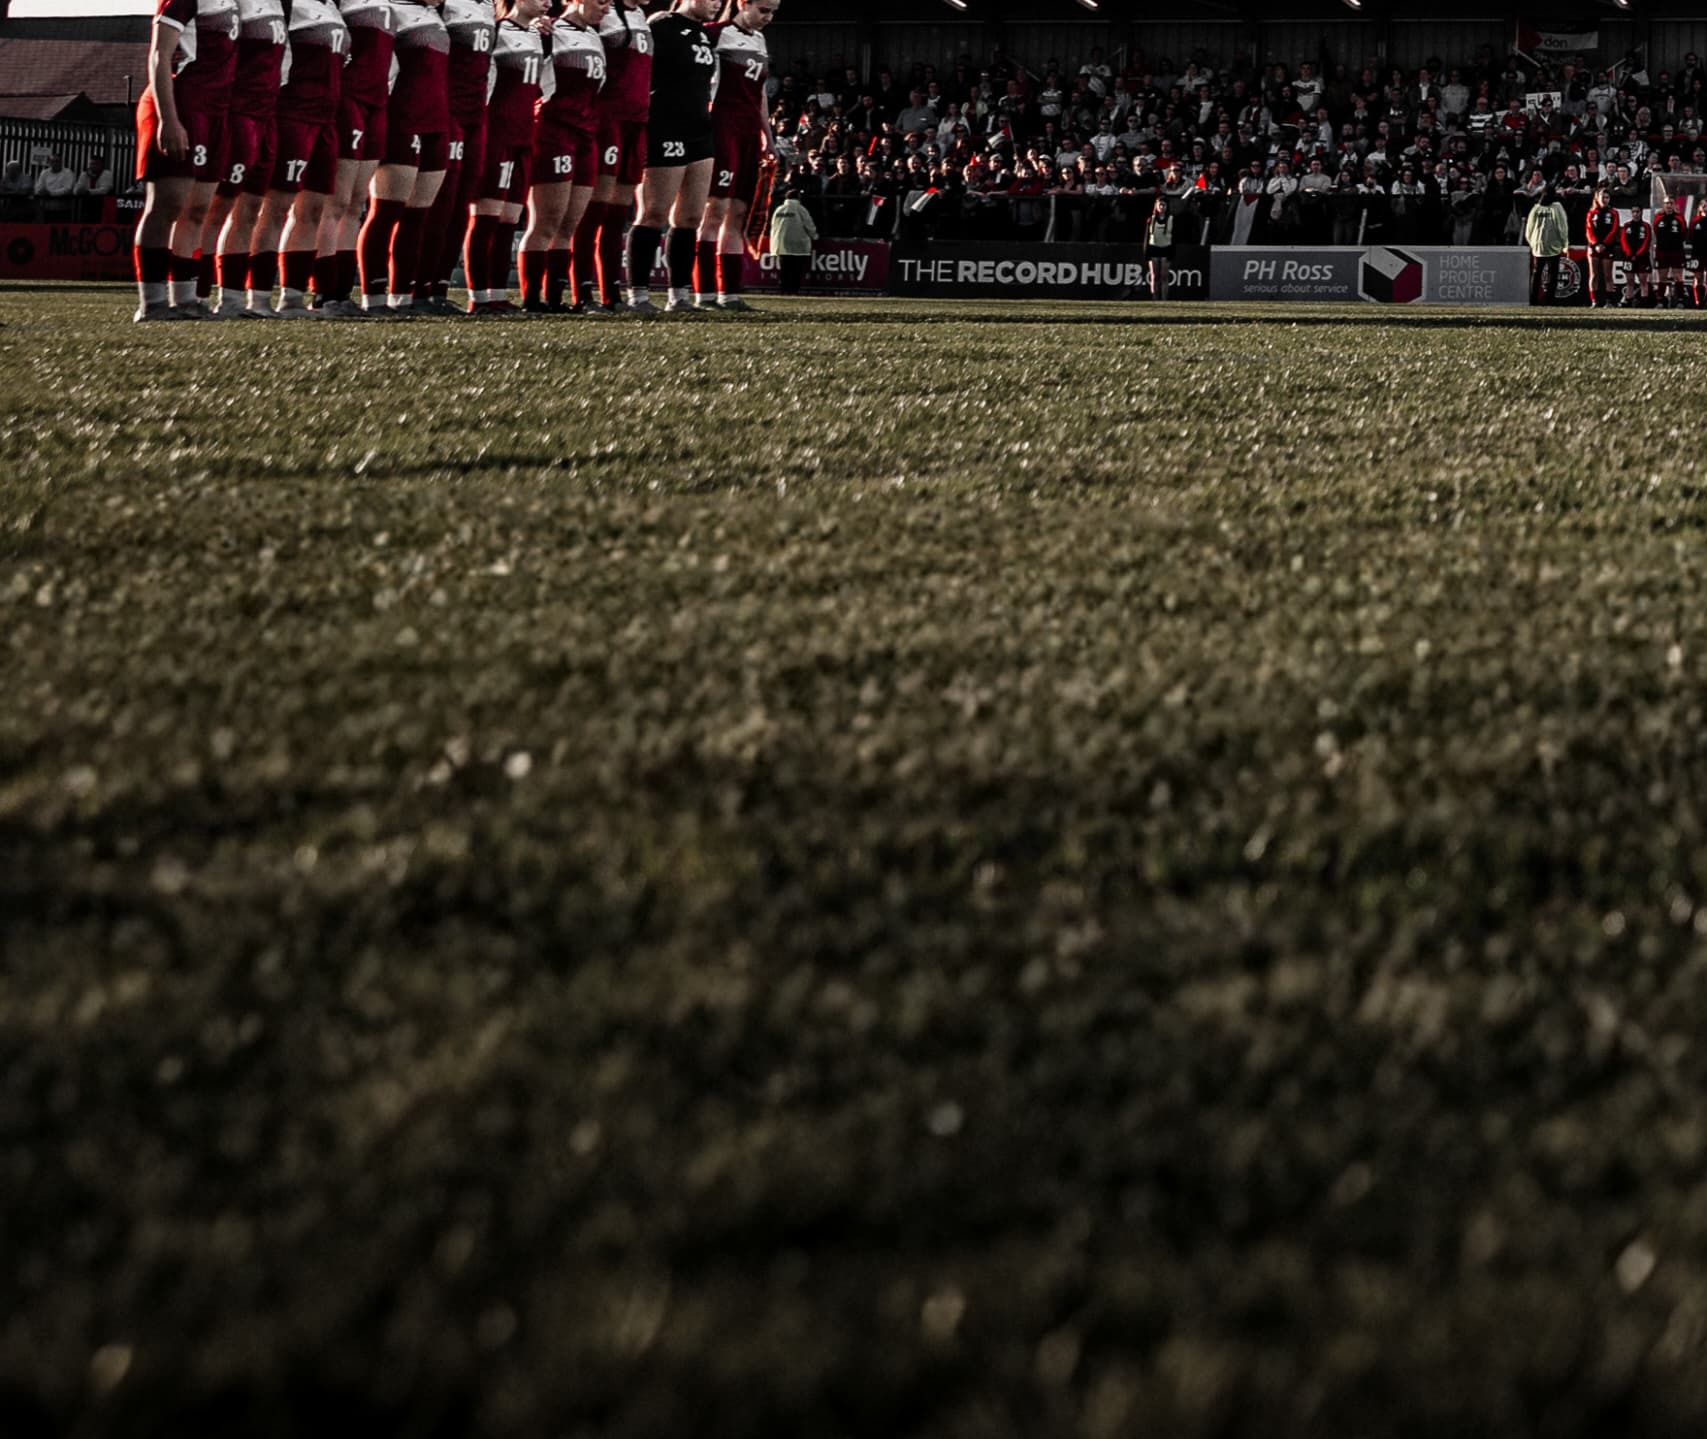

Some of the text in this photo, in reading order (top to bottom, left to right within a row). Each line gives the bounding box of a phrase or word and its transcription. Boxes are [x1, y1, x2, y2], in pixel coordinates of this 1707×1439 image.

[331, 28, 344, 53] 17
[473, 28, 490, 52] 16
[636, 32, 648, 53] 6
[691, 44, 714, 65] 23
[523, 57, 538, 85] 11
[585, 55, 605, 79] 13
[744, 58, 764, 81] 21
[352, 129, 363, 150] 7
[411, 133, 421, 154] 4
[663, 142, 685, 157] 23
[193, 144, 207, 166] 3
[449, 141, 464, 160] 16
[604, 146, 618, 165] 6
[287, 160, 307, 182] 17
[553, 155, 572, 174] 13
[116, 197, 145, 209] SAIN
[1243, 260, 1333, 280] PH Ross
[1440, 255, 1479, 269] HOME
[1440, 270, 1497, 283] PROJECT
[1243, 283, 1348, 294] serious about service
[1439, 285, 1493, 299] CENTRE
